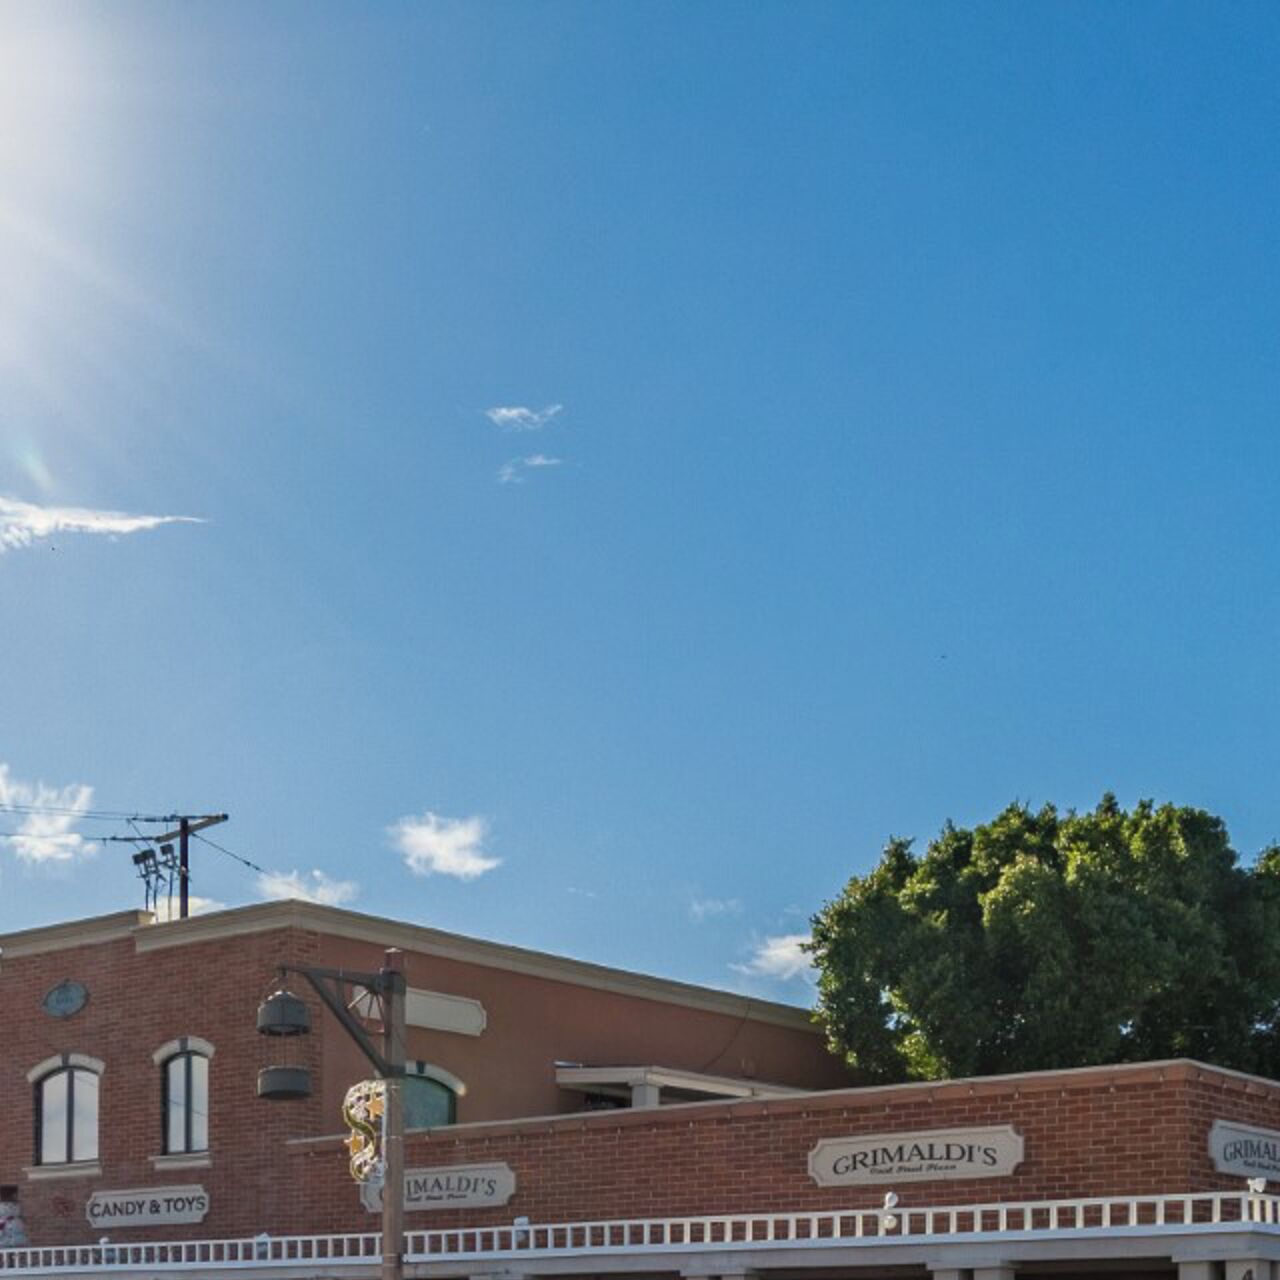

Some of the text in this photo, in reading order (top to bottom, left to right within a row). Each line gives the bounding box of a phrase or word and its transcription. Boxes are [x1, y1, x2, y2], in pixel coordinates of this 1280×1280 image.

[832, 1142, 998, 1176] GRIMALDI'S
[379, 1176, 497, 1202] IMALDI'S
[90, 1195, 206, 1218] CANDY & TOYS
